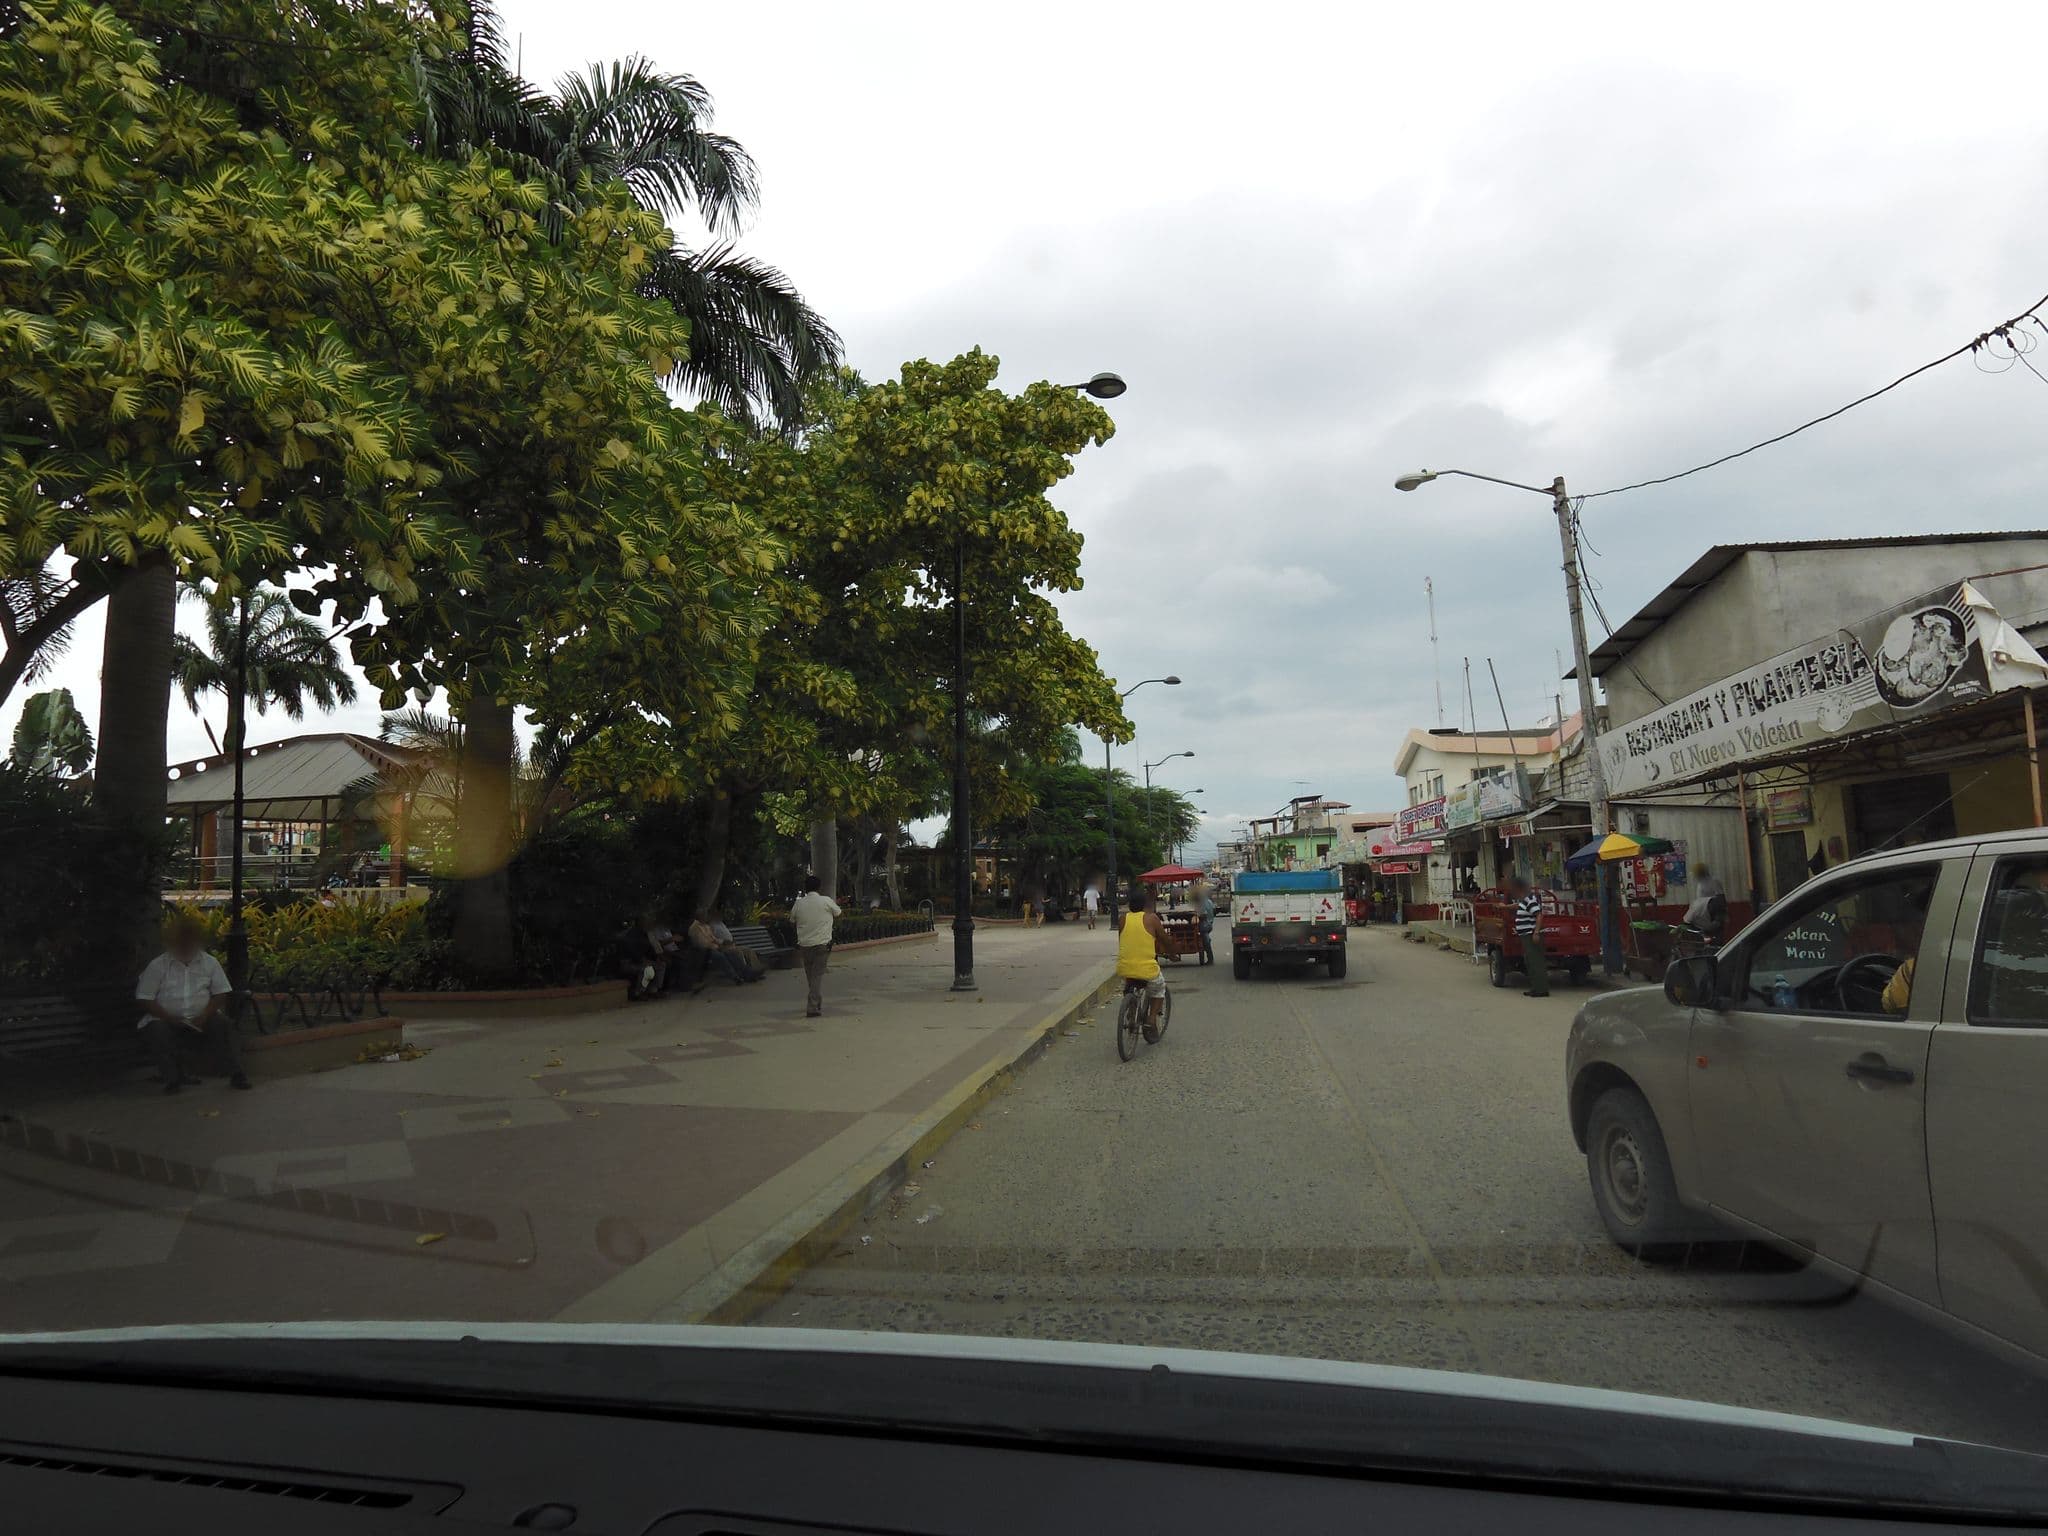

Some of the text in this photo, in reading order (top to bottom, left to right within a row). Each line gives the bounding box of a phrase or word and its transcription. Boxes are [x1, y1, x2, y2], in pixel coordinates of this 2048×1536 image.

[1625, 638, 1873, 757] RESTAURANT Y PICANTERIA
[1669, 717, 1803, 775] El Nuevo Volcán
[1785, 927, 1831, 942] olcan
[1786, 947, 1826, 959] Menú
